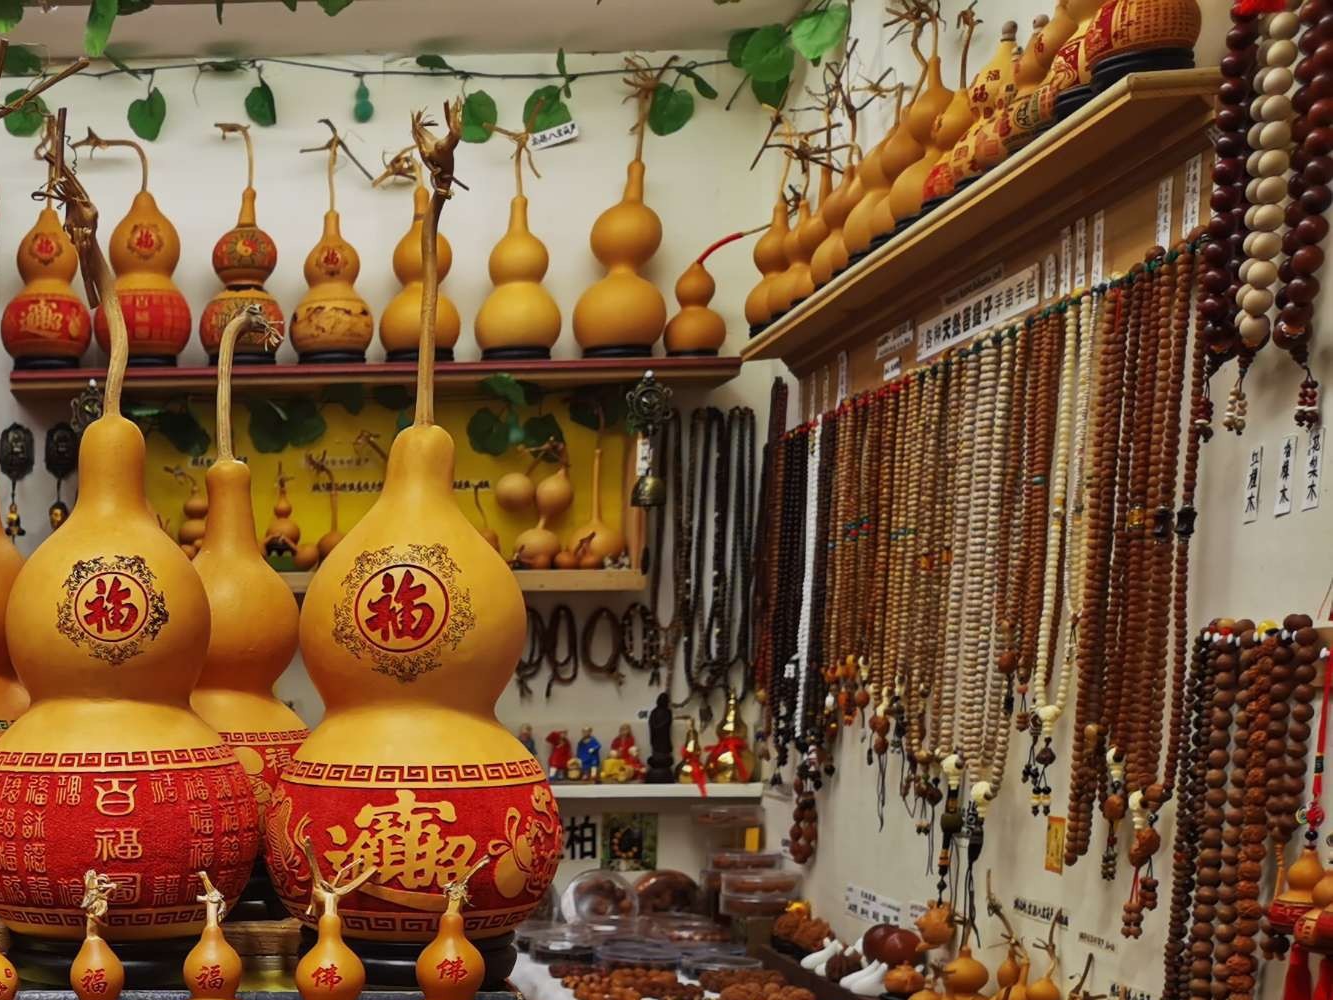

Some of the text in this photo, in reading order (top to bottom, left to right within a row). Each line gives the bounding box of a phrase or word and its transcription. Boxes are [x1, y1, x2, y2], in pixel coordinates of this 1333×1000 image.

[83, 576, 139, 634] 福
[365, 569, 436, 642] 福
[558, 816, 597, 860] 柏
[81, 967, 107, 995] 福
[195, 964, 225, 992] 福
[311, 963, 343, 991] 佛
[435, 956, 469, 985] 佛
